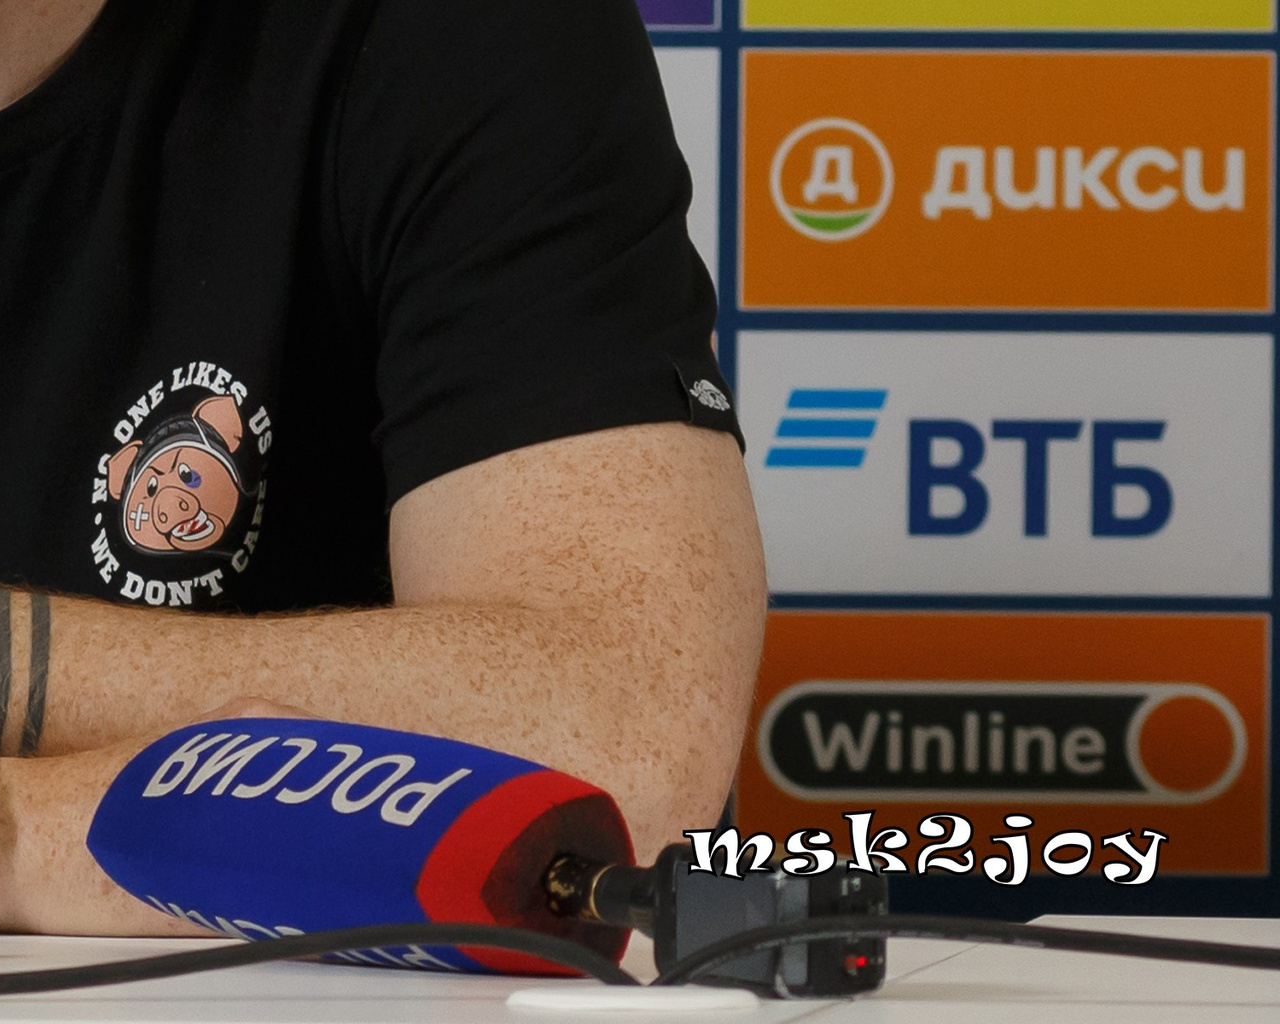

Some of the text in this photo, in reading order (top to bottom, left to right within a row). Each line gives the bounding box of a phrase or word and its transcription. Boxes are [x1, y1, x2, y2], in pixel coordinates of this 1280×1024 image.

[114, 380, 164, 444] ONE
[171, 361, 248, 406] LIKES
[249, 406, 272, 455] US
[907, 419, 1174, 538] ВТБ
[91, 528, 120, 584] WE
[120, 568, 223, 607] DON'T
[142, 733, 472, 827] РОССИЯ
[803, 711, 1106, 774] Winline
